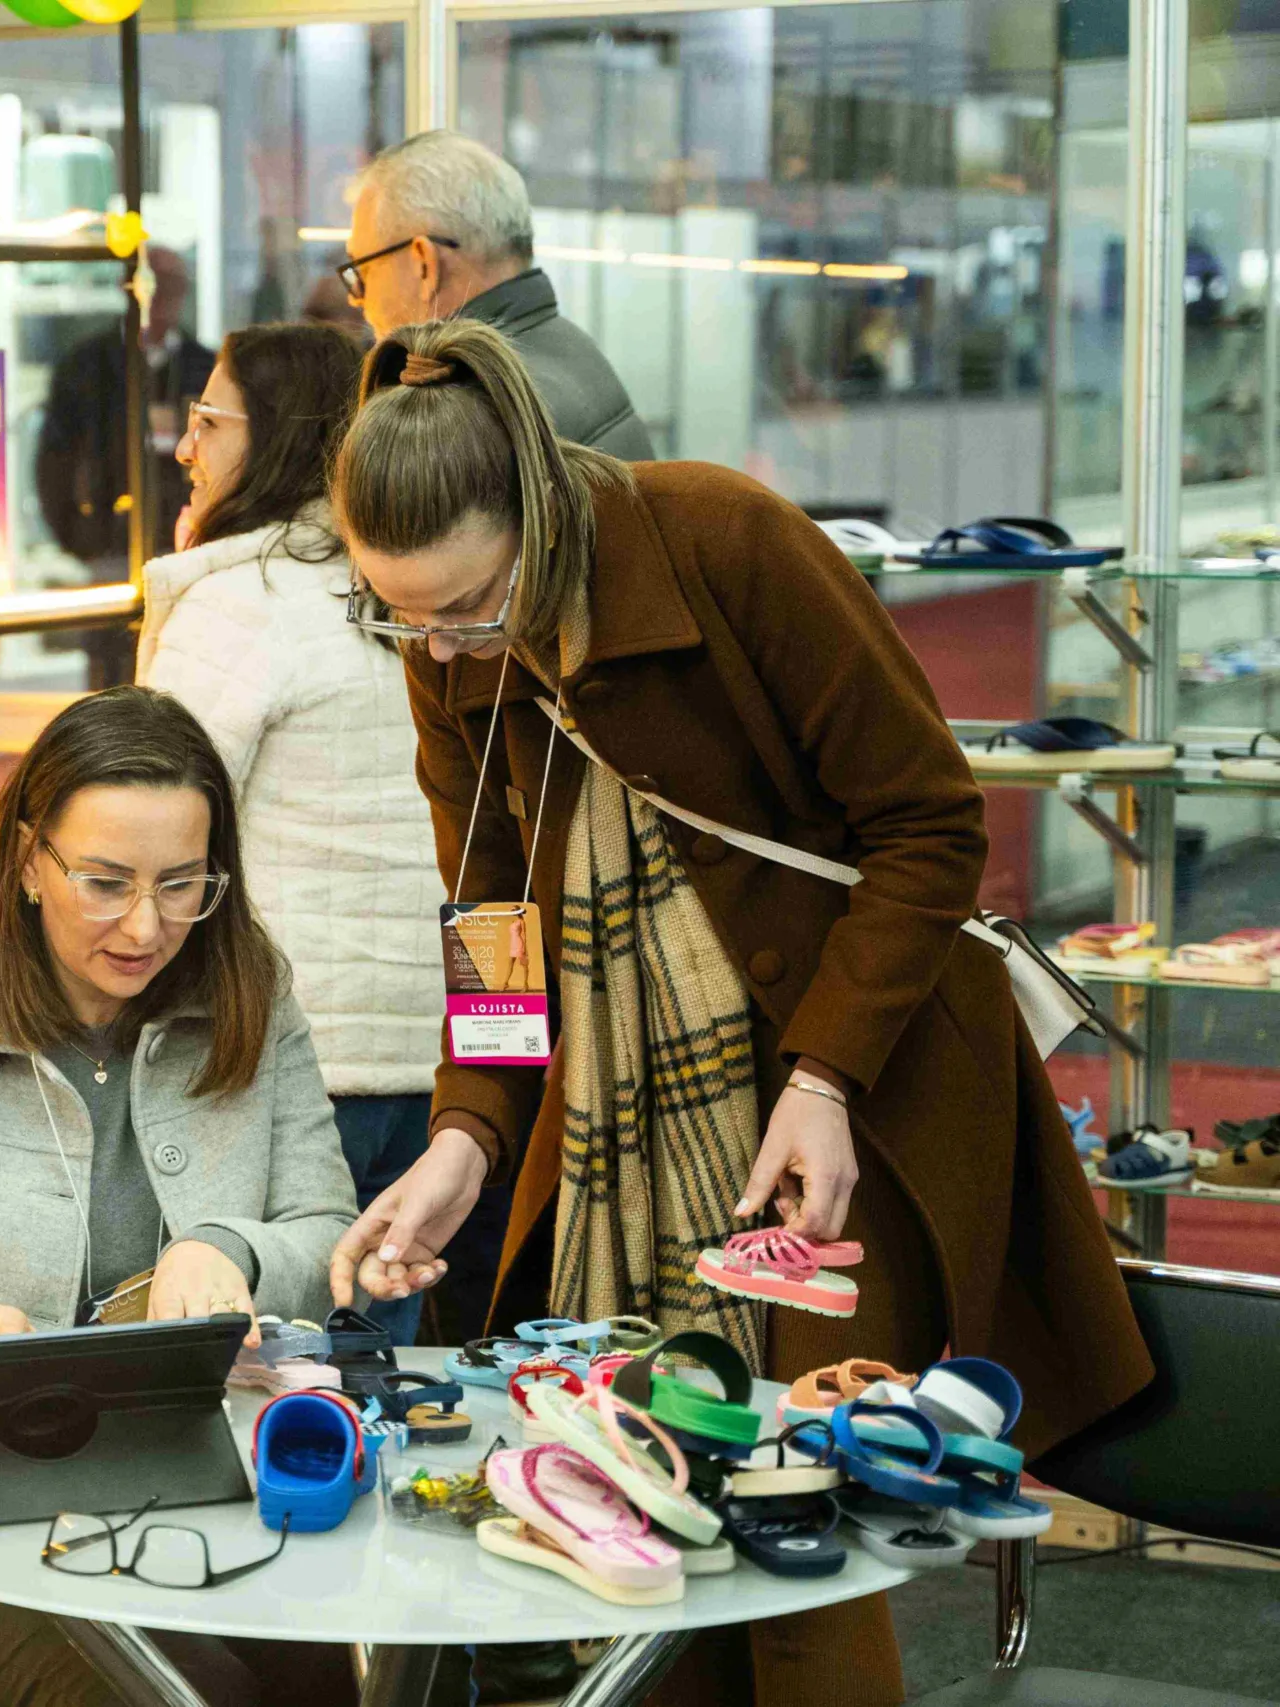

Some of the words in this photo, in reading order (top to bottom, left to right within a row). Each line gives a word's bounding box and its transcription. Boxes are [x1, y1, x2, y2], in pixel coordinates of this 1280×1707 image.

[464, 914, 499, 926] SICC
[453, 946, 462, 954] 29
[479, 946, 495, 959] 20
[480, 960, 495, 973] 26
[471, 1004, 525, 1013] LOJISTA
[107, 1291, 139, 1312] SICC
